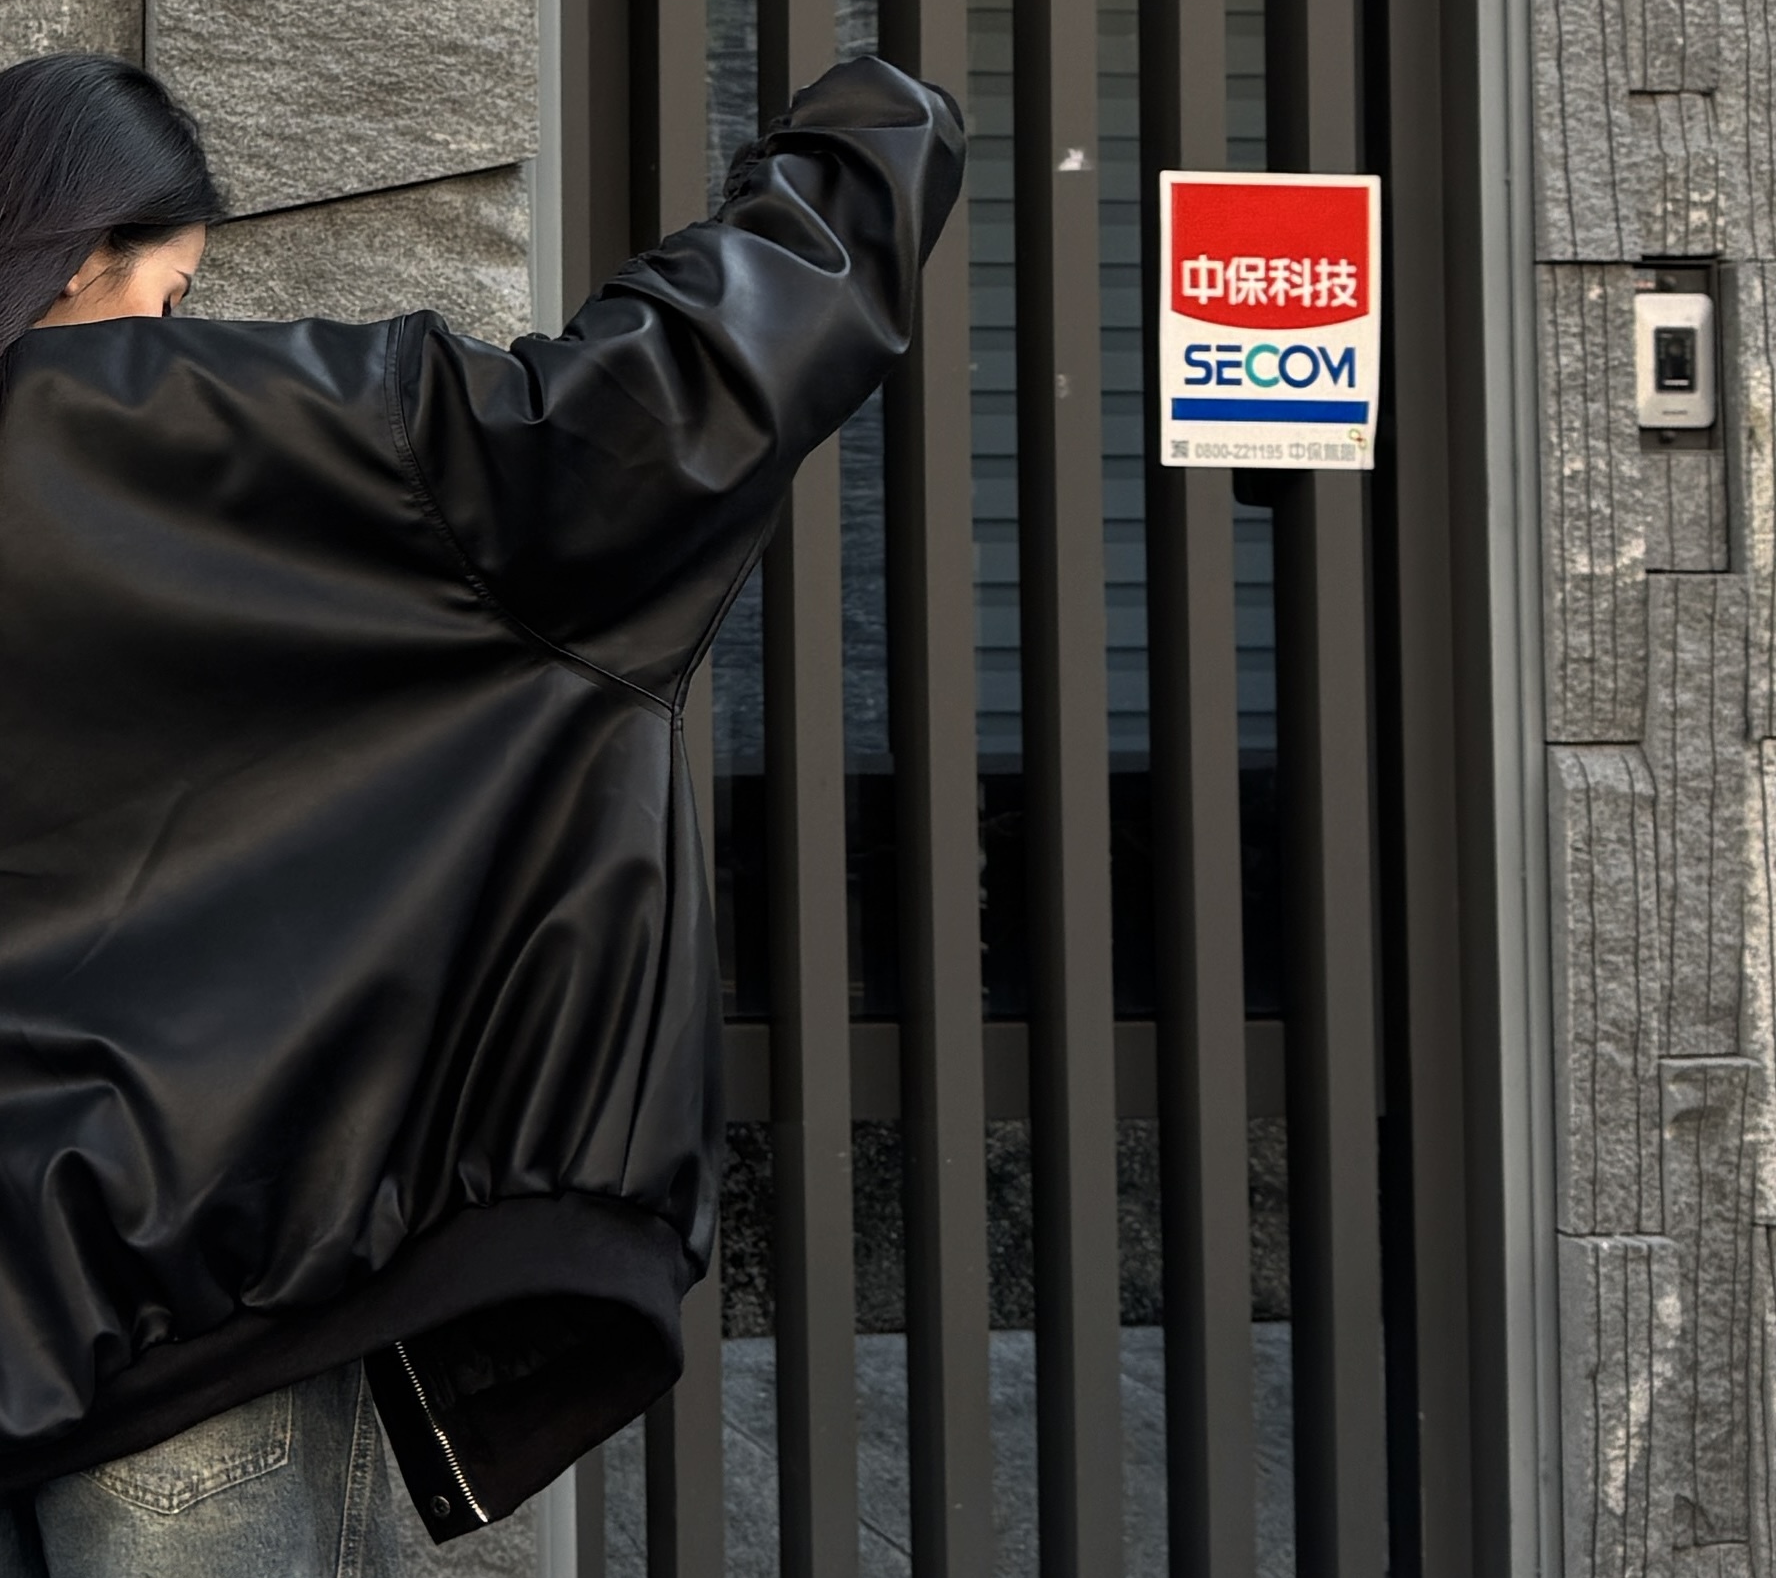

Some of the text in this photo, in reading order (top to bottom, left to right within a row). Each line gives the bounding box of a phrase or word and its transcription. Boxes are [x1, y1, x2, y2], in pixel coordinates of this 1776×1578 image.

[1181, 254, 1358, 308] 中保科技
[1184, 343, 1356, 388] SECOM
